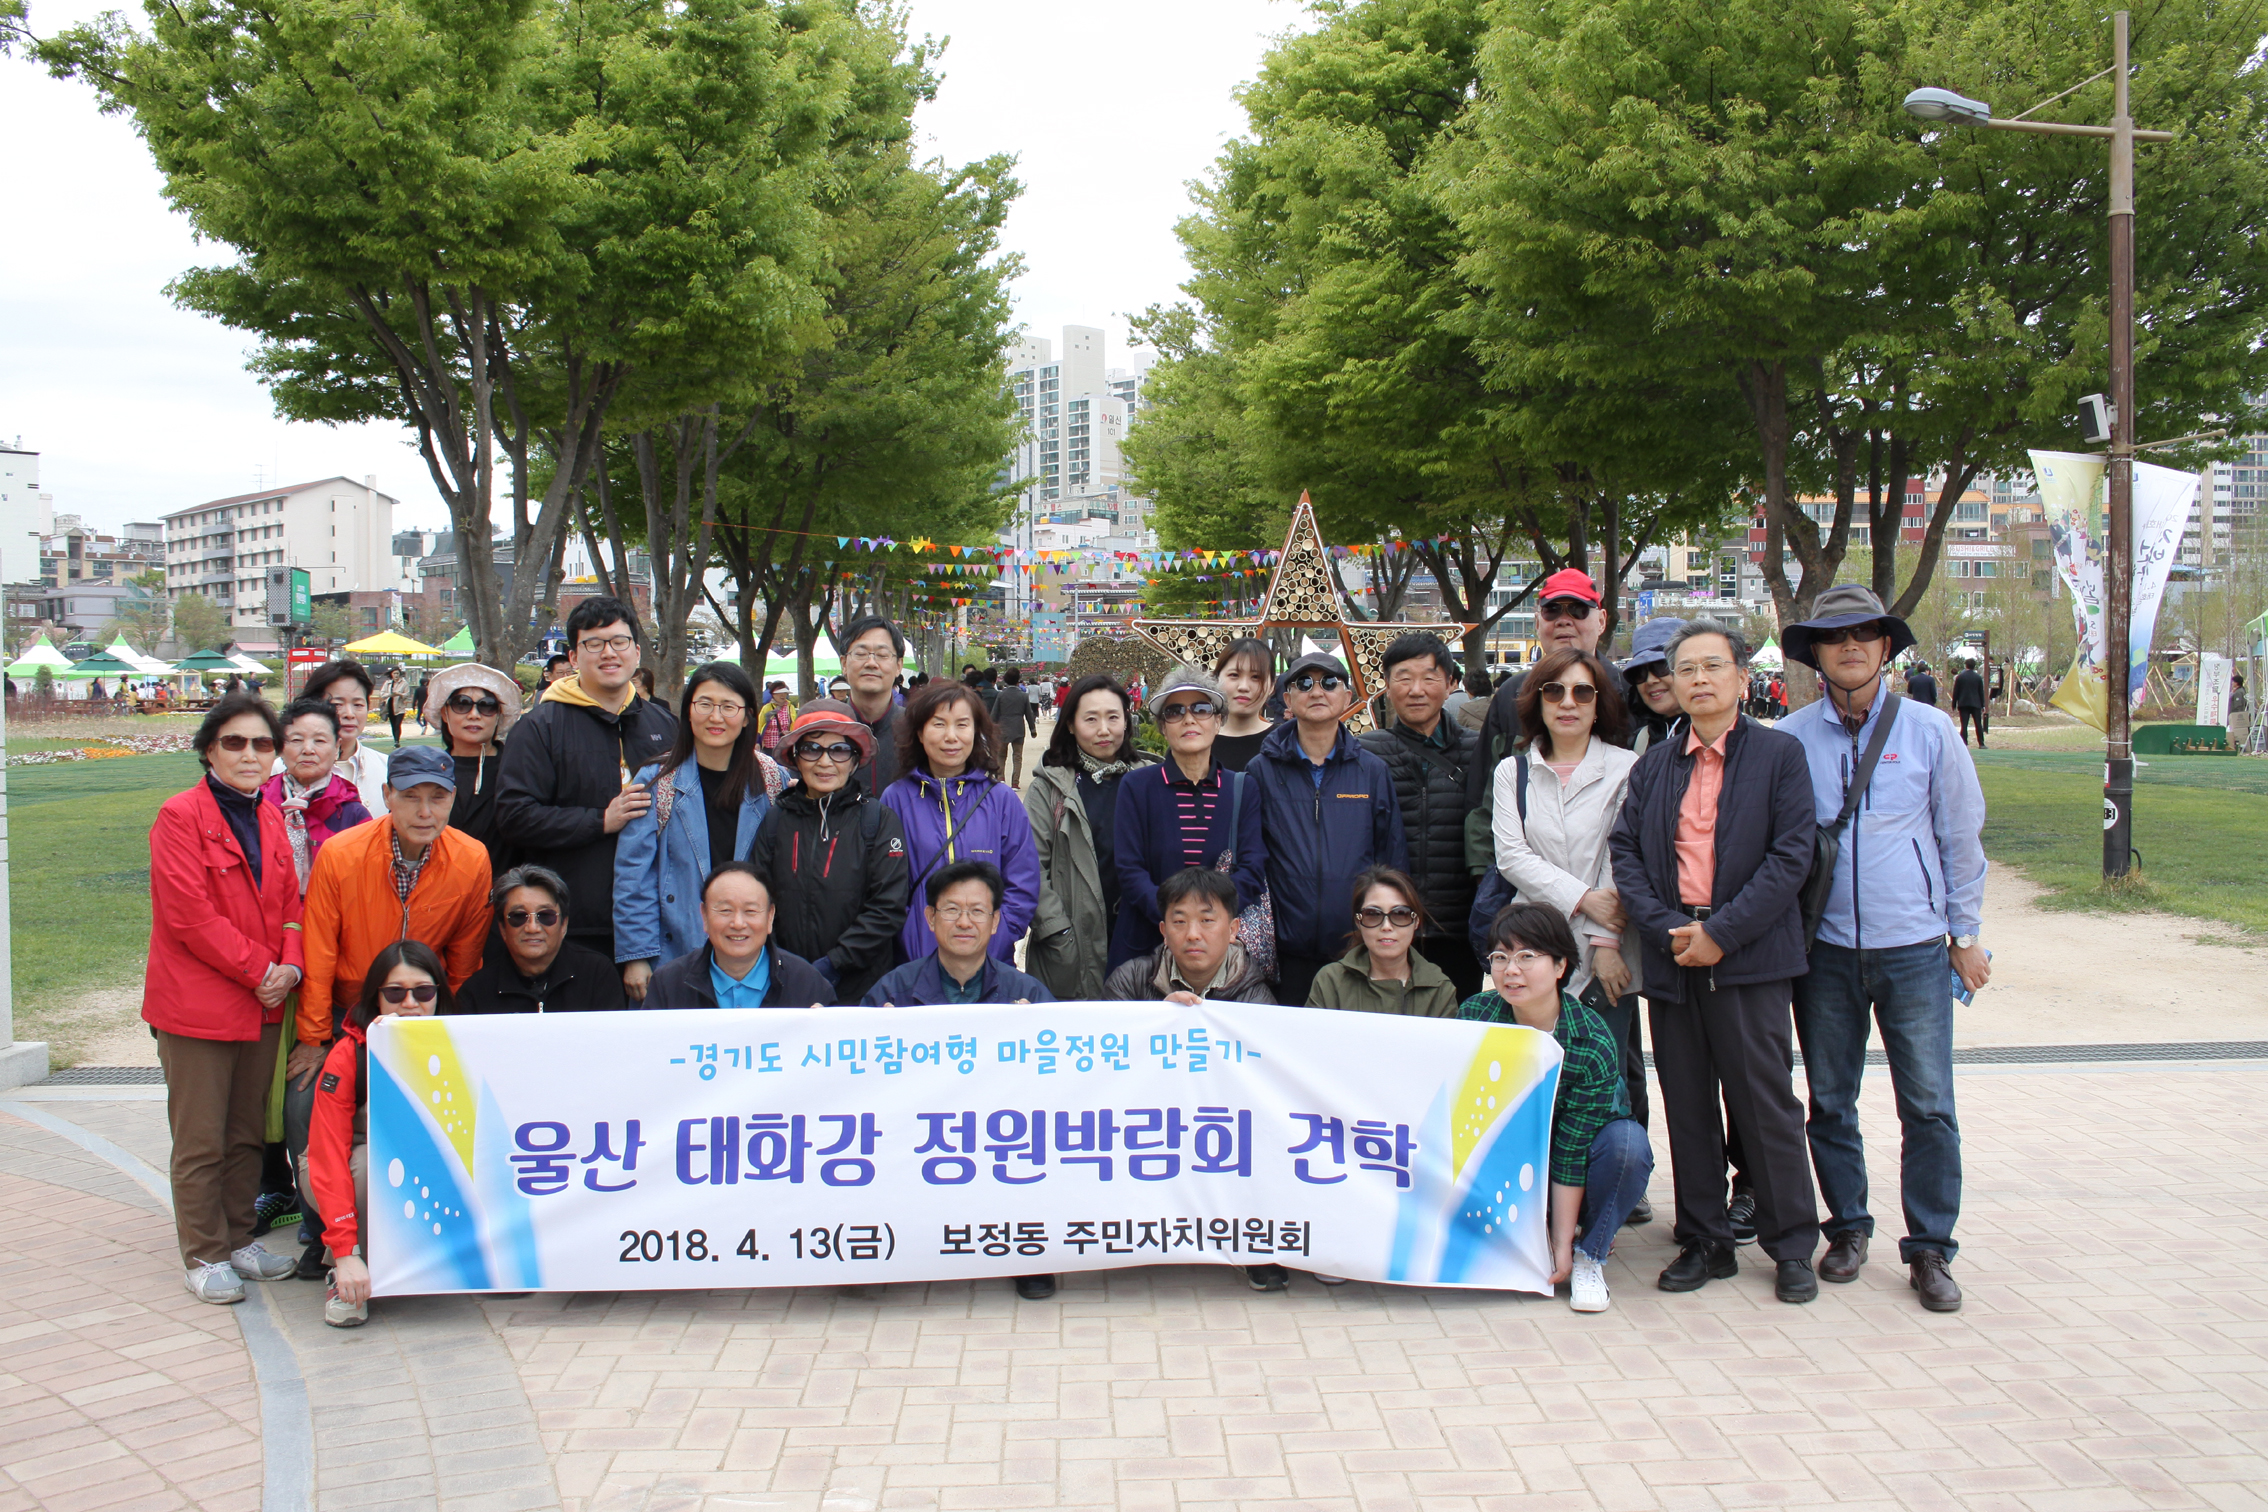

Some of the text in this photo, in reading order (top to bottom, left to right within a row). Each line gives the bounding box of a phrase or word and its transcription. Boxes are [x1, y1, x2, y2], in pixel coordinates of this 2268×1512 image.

[1107, 428, 1116, 436] 101
[801, 1034, 977, 1075] 시민참여형
[998, 1029, 1131, 1075] 마을정원
[510, 1106, 1418, 1196] 울산 태화강 정원박람회 견학
[619, 1217, 1311, 1262] 2018. 4. 13(금) 보정동 주민자치위원회
